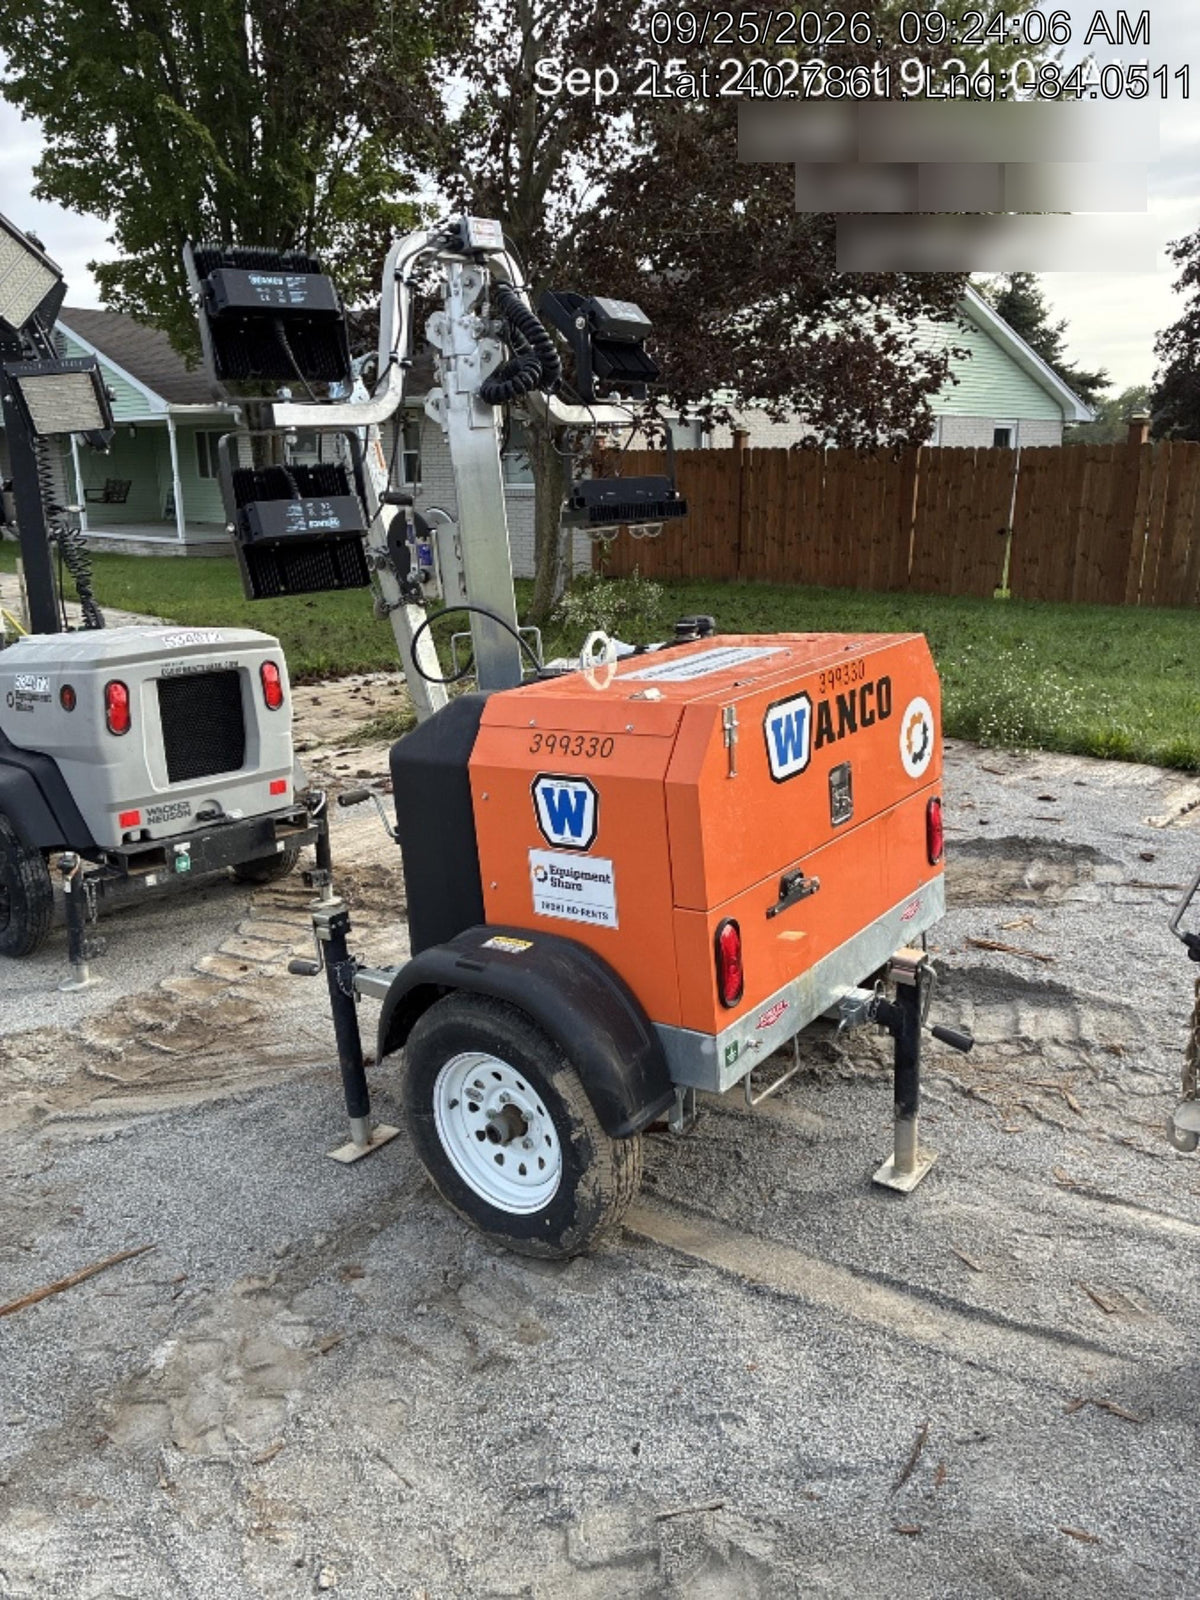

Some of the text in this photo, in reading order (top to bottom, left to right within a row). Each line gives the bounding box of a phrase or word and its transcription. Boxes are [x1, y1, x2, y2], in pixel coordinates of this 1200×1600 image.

[818, 659, 866, 694] 399330
[529, 733, 615, 758] 399330
[541, 786, 588, 839] W
[549, 864, 611, 884] Equipment
[550, 876, 583, 892] Share
